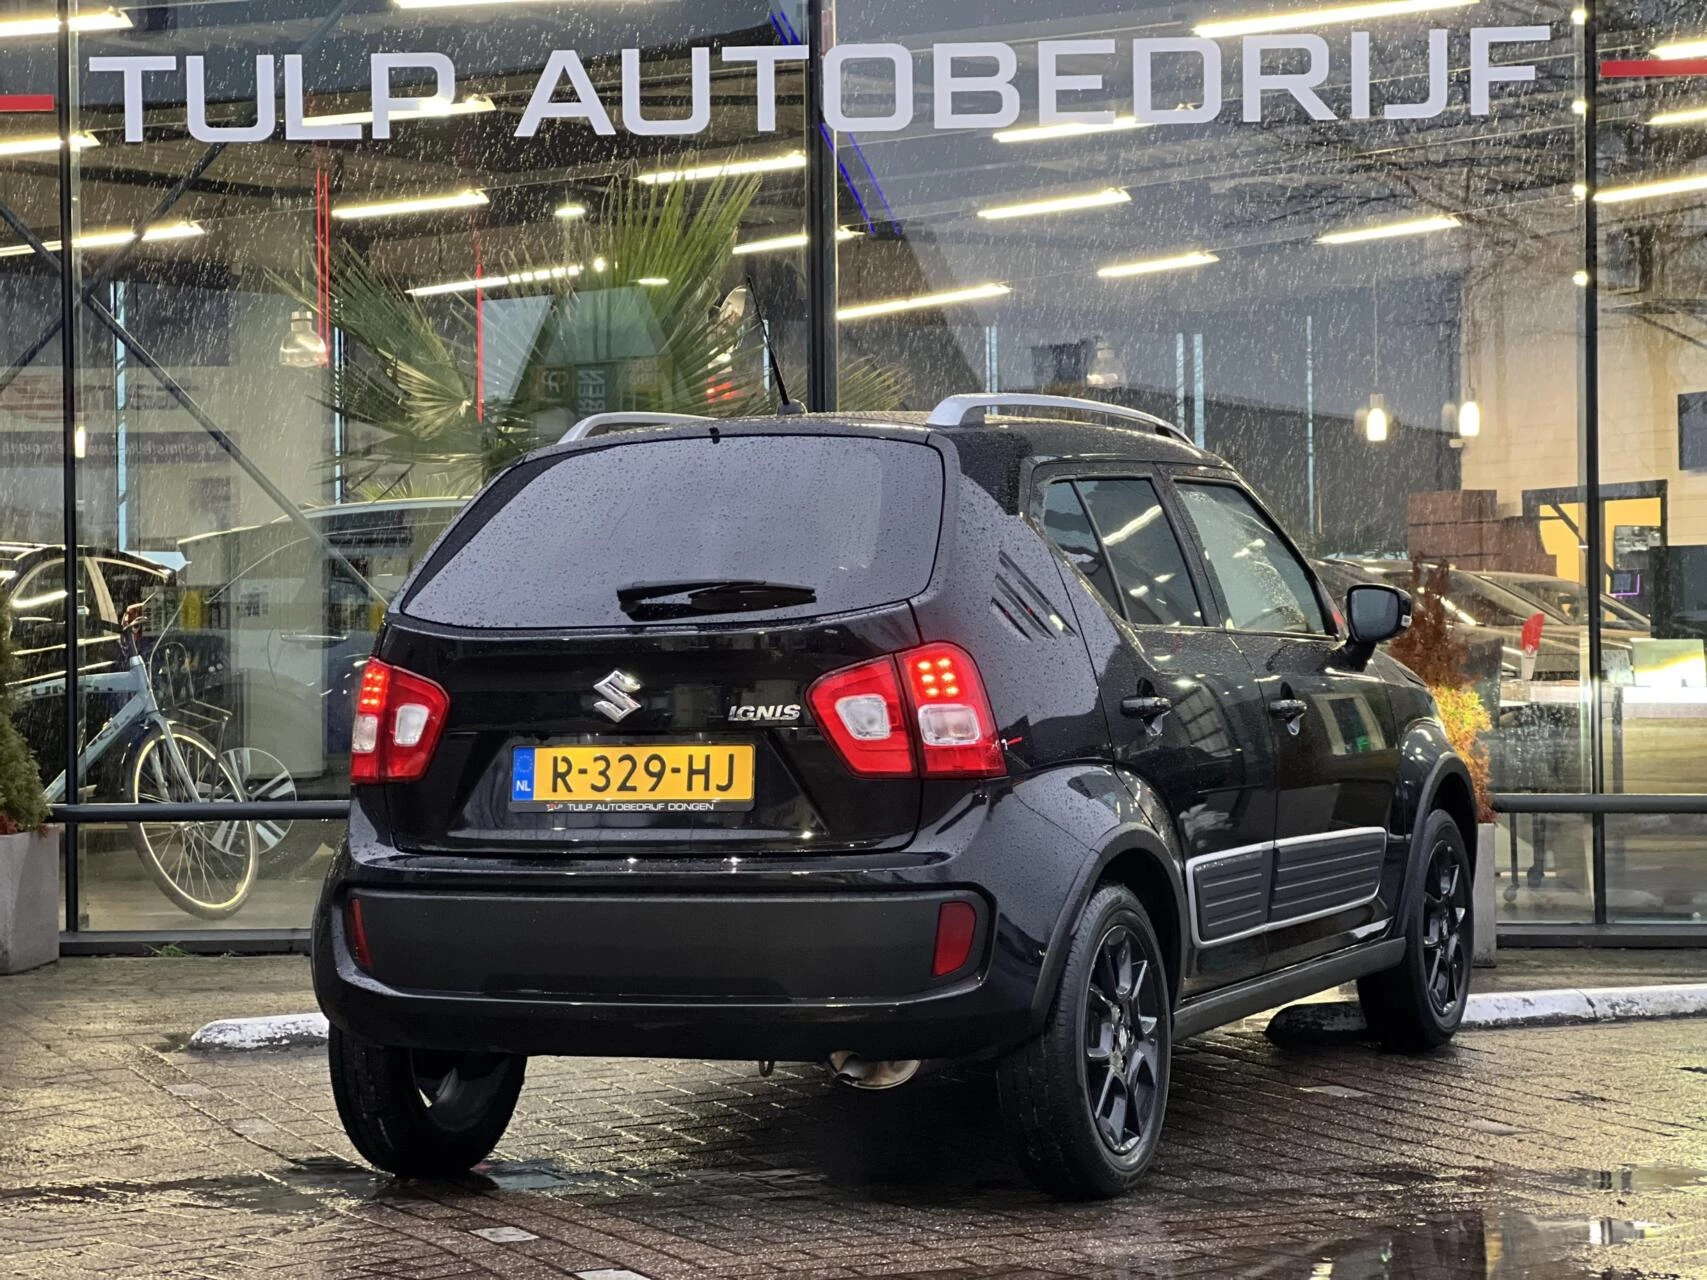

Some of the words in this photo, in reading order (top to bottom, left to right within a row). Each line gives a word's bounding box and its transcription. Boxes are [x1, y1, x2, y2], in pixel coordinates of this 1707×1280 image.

[89, 52, 456, 143] TULP
[514, 25, 1551, 139] AUTOBEDRIJF
[728, 704, 801, 721] IGNIS
[551, 753, 735, 793] R-329-HJ
[516, 780, 531, 791] NL
[568, 803, 593, 811] TULP
[595, 803, 664, 811] AUTOBEDRIJF
[667, 803, 714, 811] DONGEN
